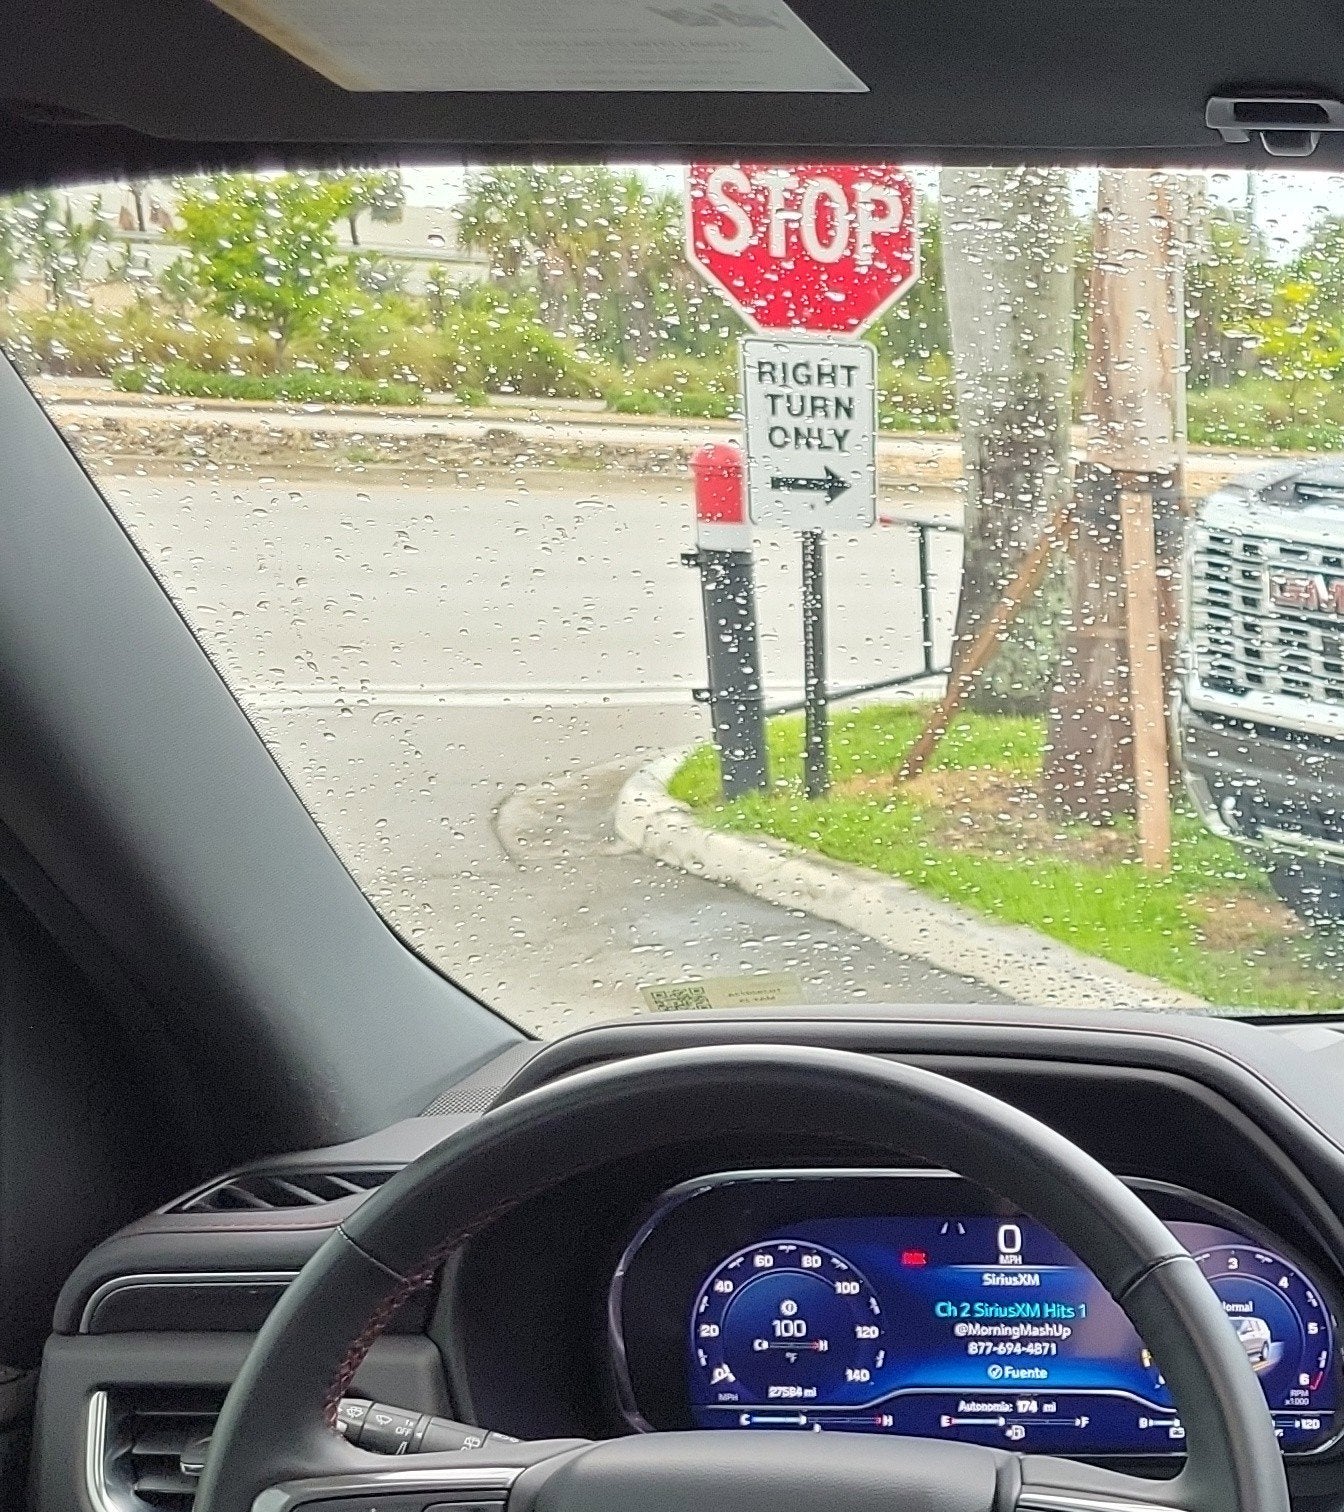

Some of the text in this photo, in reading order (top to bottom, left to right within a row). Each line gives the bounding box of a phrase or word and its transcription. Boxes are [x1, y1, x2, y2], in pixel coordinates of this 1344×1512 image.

[703, 166, 904, 266] STOP
[758, 360, 860, 388] RIGHT
[764, 393, 855, 420] TURN
[768, 425, 851, 451] ONLY
[997, 1224, 1022, 1253] 0
[753, 1255, 774, 1268] 60
[801, 1255, 822, 1268] 80
[999, 1255, 1023, 1265] MPH
[1227, 1258, 1239, 1270] 3
[713, 1280, 734, 1293] 40
[982, 1273, 1041, 1287] SiriusXM
[1278, 1276, 1290, 1289] 4
[835, 1281, 860, 1295] 100
[935, 1301, 1086, 1318] Ch 2 SiriusXM Hits 1
[700, 1324, 720, 1337] 20
[771, 1319, 807, 1338] 100
[855, 1325, 879, 1339] 120
[954, 1322, 1072, 1340] @MorningMashUp
[1307, 1322, 1319, 1335] 5
[967, 1341, 1057, 1356] 877-694-4871
[845, 1368, 870, 1382] 140
[1004, 1366, 1048, 1379] Fuente
[1299, 1373, 1310, 1386] 6
[803, 1386, 817, 1398] mi
[1290, 1389, 1310, 1398] RPM
[1042, 1401, 1057, 1413] mi
